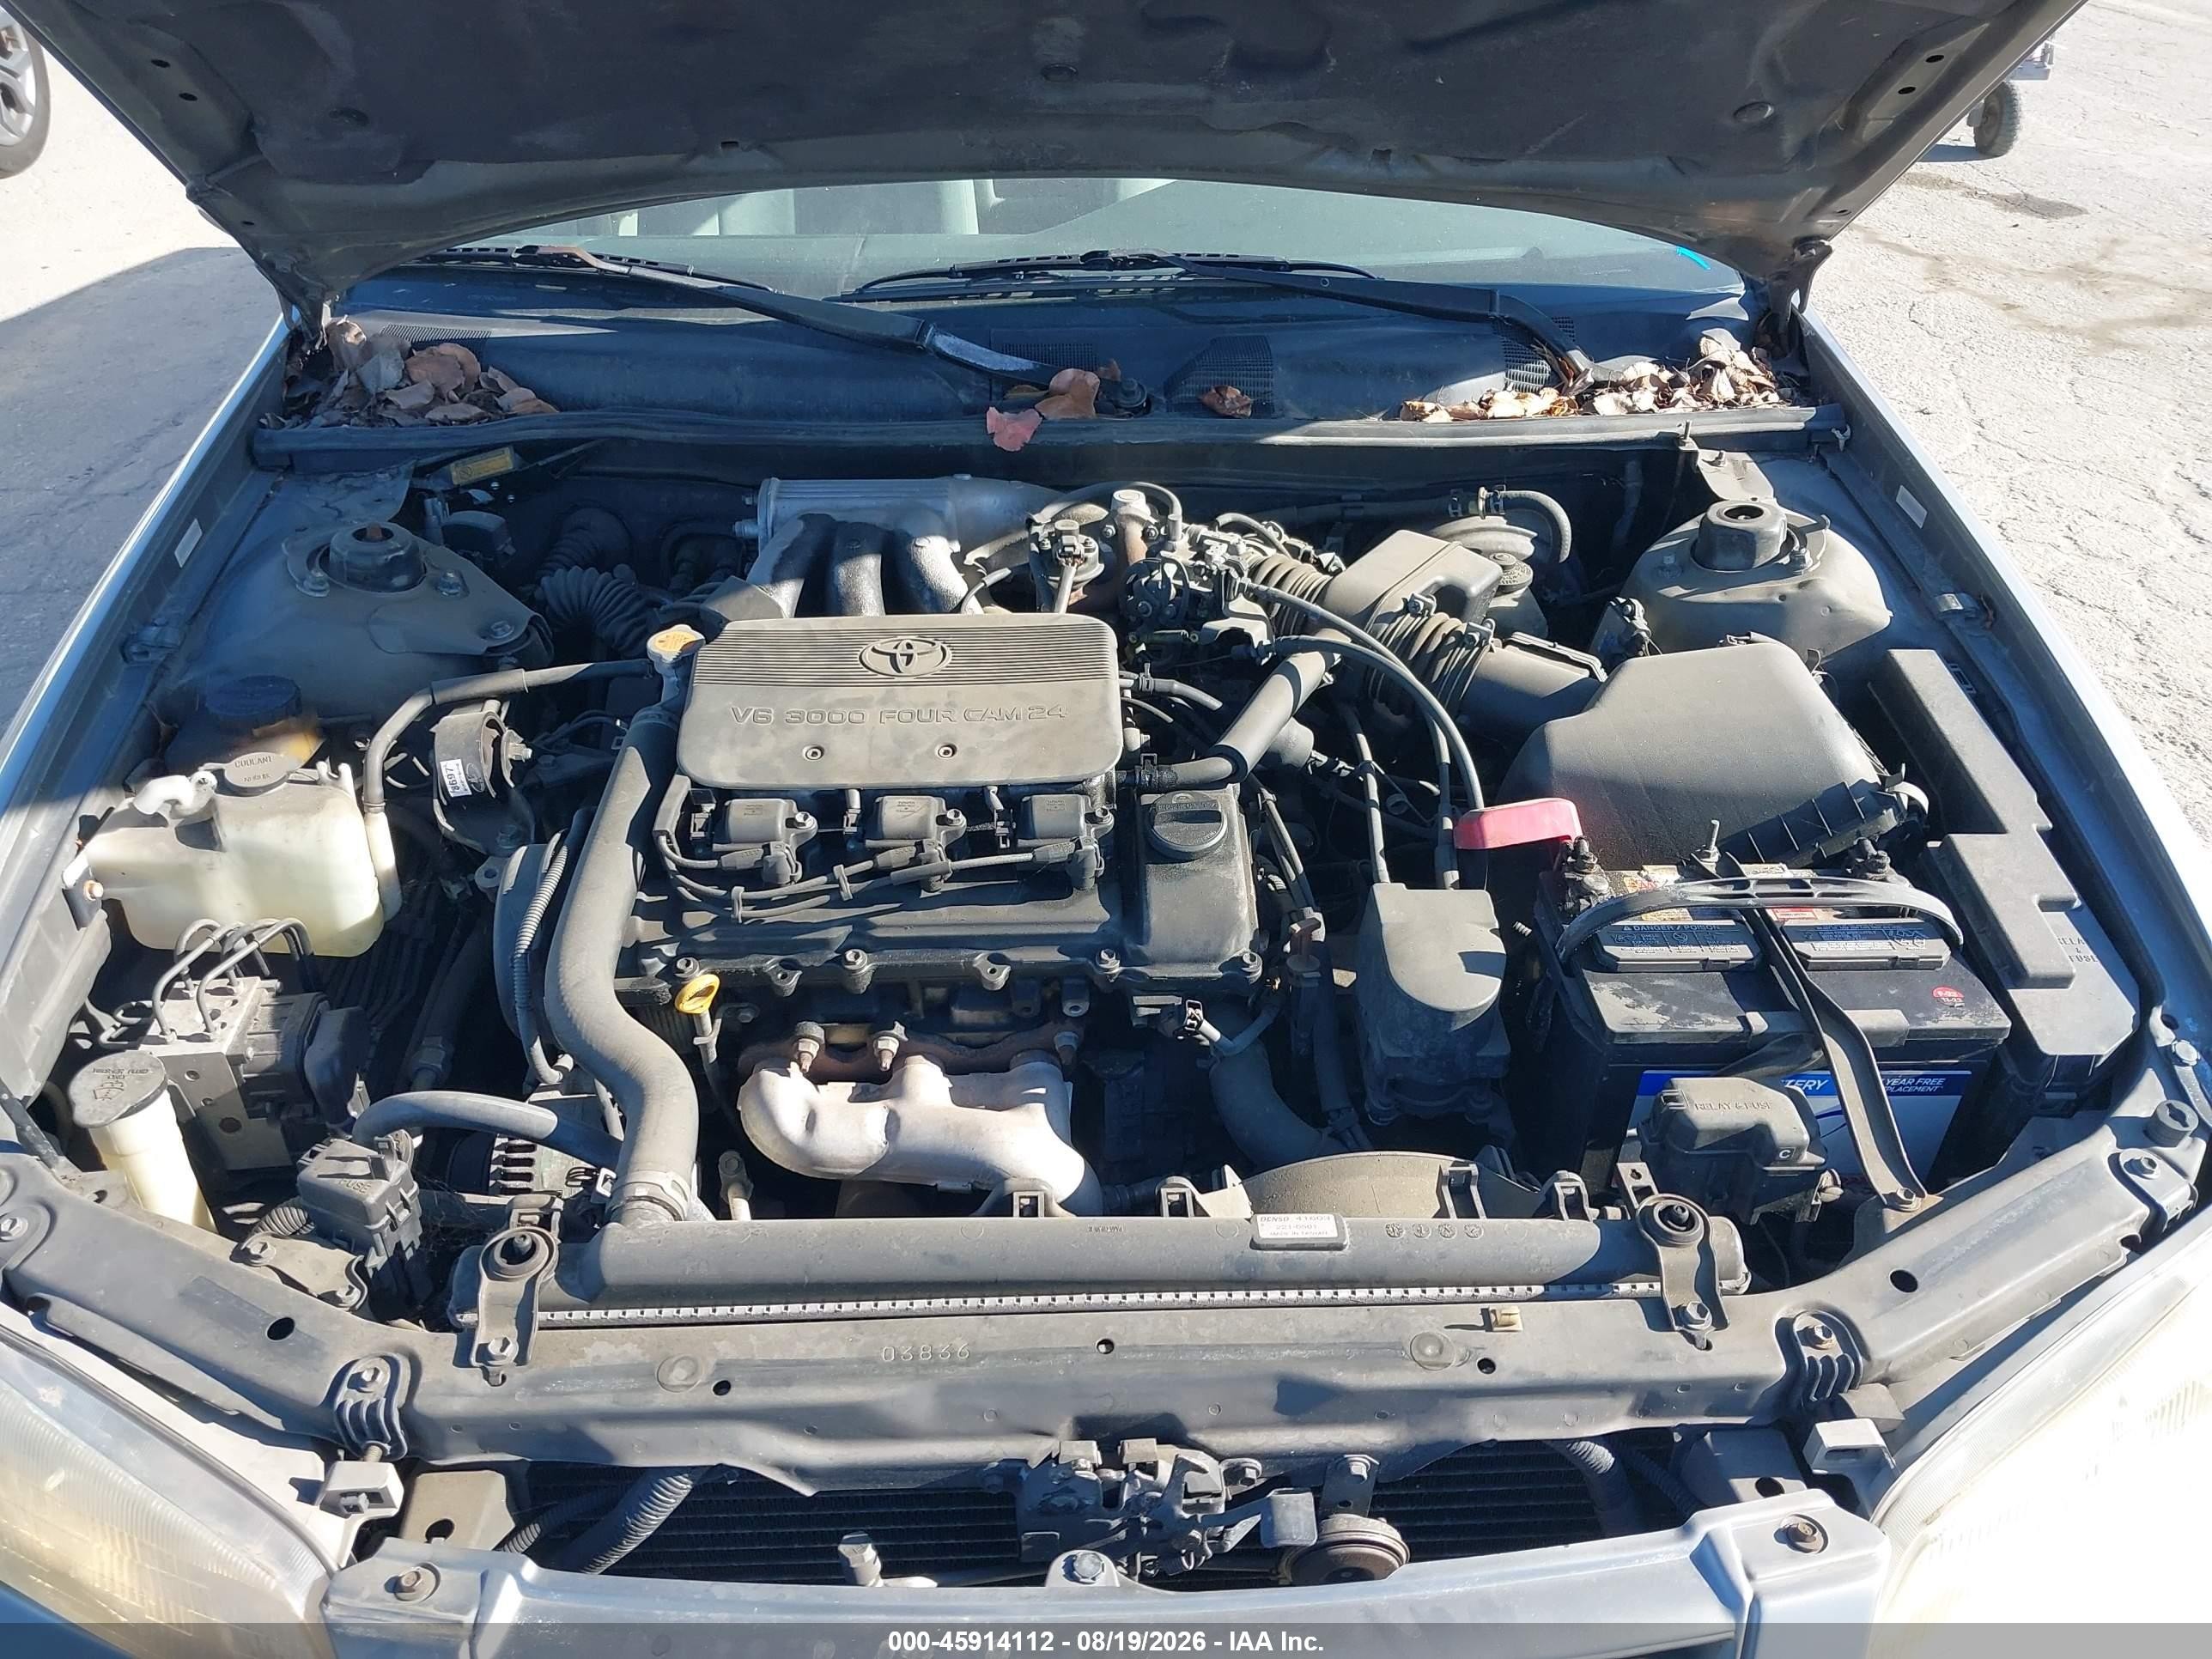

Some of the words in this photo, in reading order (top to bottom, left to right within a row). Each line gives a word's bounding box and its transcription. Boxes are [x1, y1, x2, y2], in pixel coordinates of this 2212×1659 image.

[731, 707, 773, 725] V6
[785, 708, 866, 725] 3000
[878, 708, 957, 725] FOUR
[963, 706, 1022, 723] CAM
[1027, 703, 1066, 720] 24
[1694, 1102, 1731, 1111] RELAY
[1778, 1149, 1790, 1159] C
